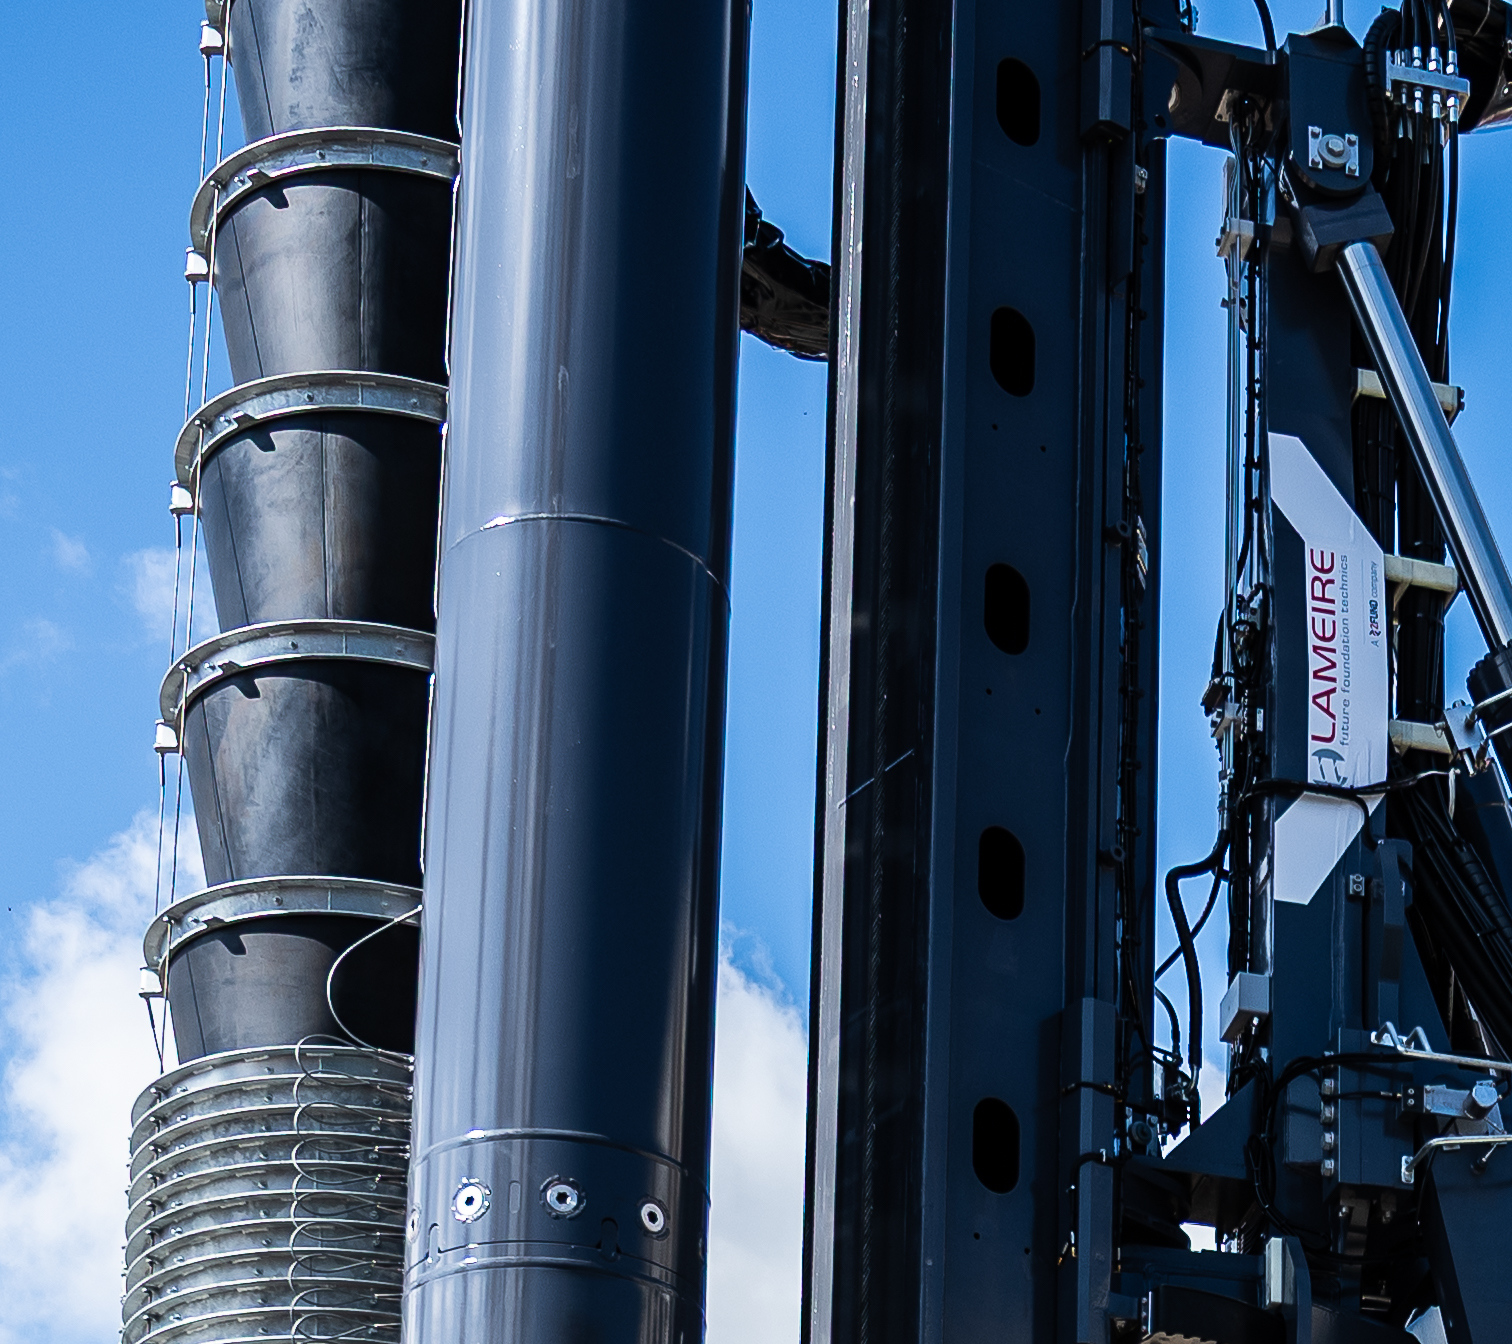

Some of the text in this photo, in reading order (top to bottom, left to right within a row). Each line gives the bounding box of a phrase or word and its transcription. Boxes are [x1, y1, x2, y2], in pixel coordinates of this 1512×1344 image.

[1310, 548, 1338, 743] LAMEIRE
[1339, 555, 1351, 746] future foundation technics
